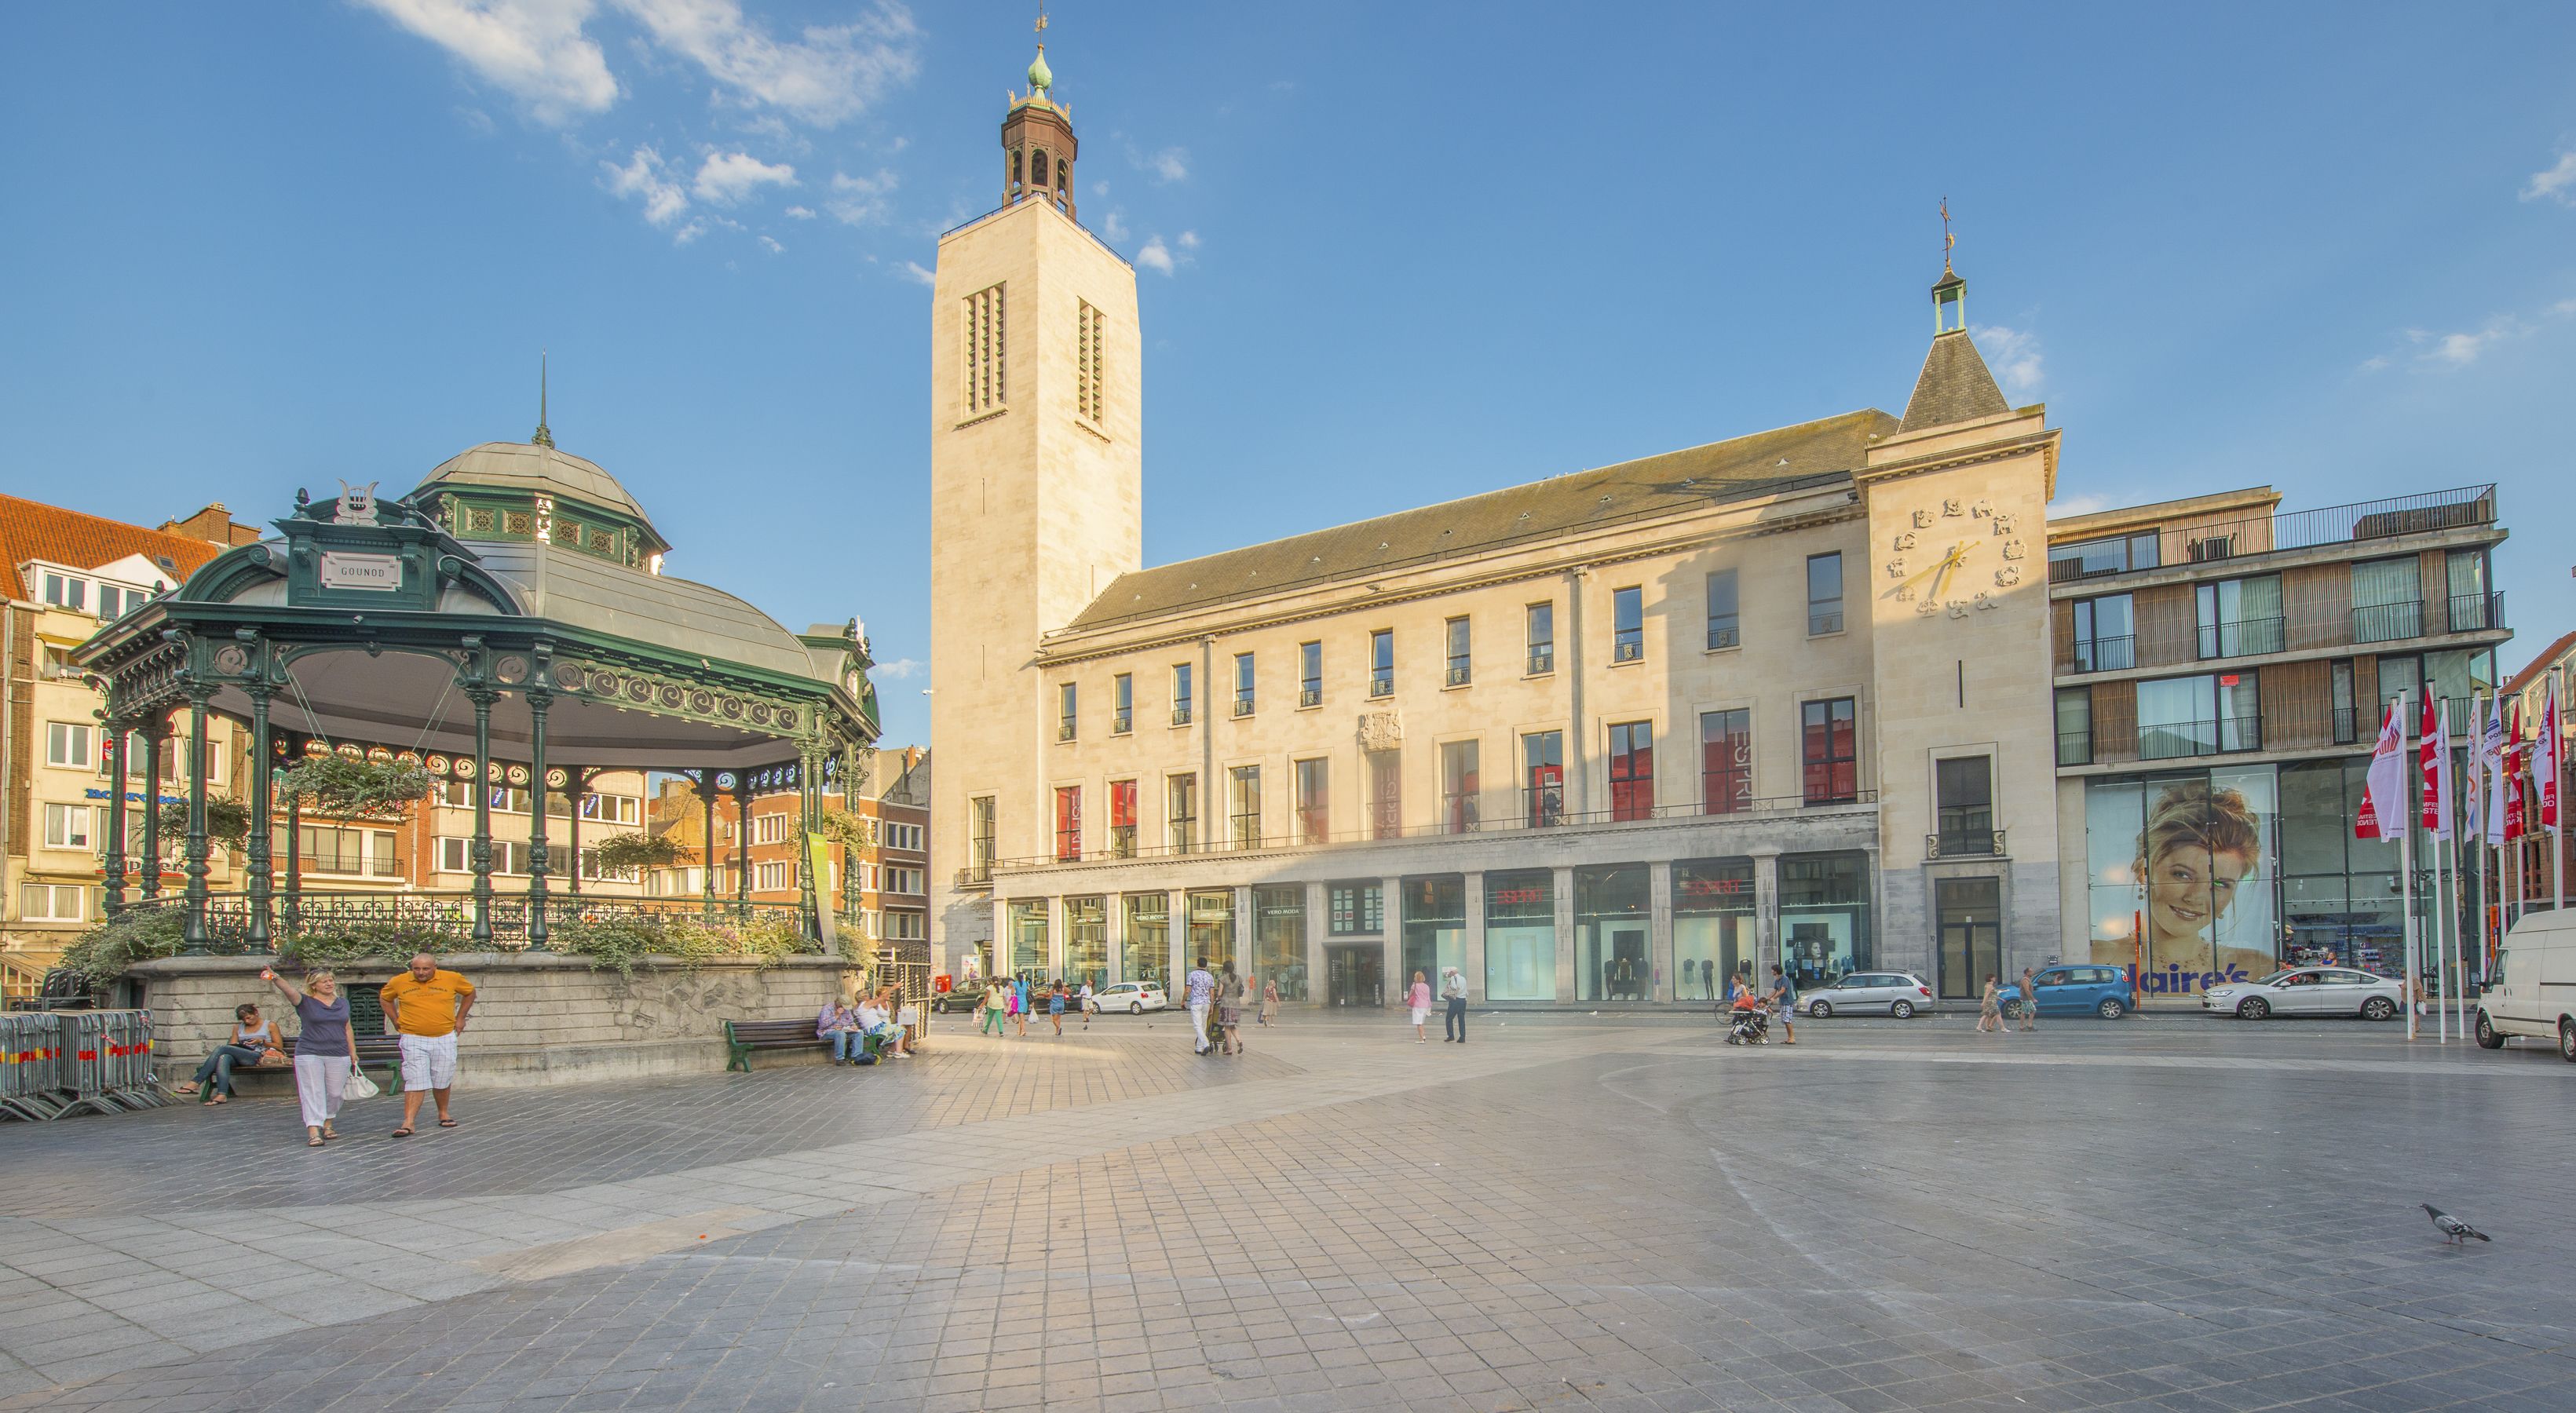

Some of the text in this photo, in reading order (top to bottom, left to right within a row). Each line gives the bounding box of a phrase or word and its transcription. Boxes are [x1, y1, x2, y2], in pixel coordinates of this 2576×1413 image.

[342, 567, 385, 577] GOUNOD
[1684, 878, 1742, 896] ESPRIT
[1497, 889, 1545, 904] ESPRIT
[2128, 962, 2249, 993] laire's
